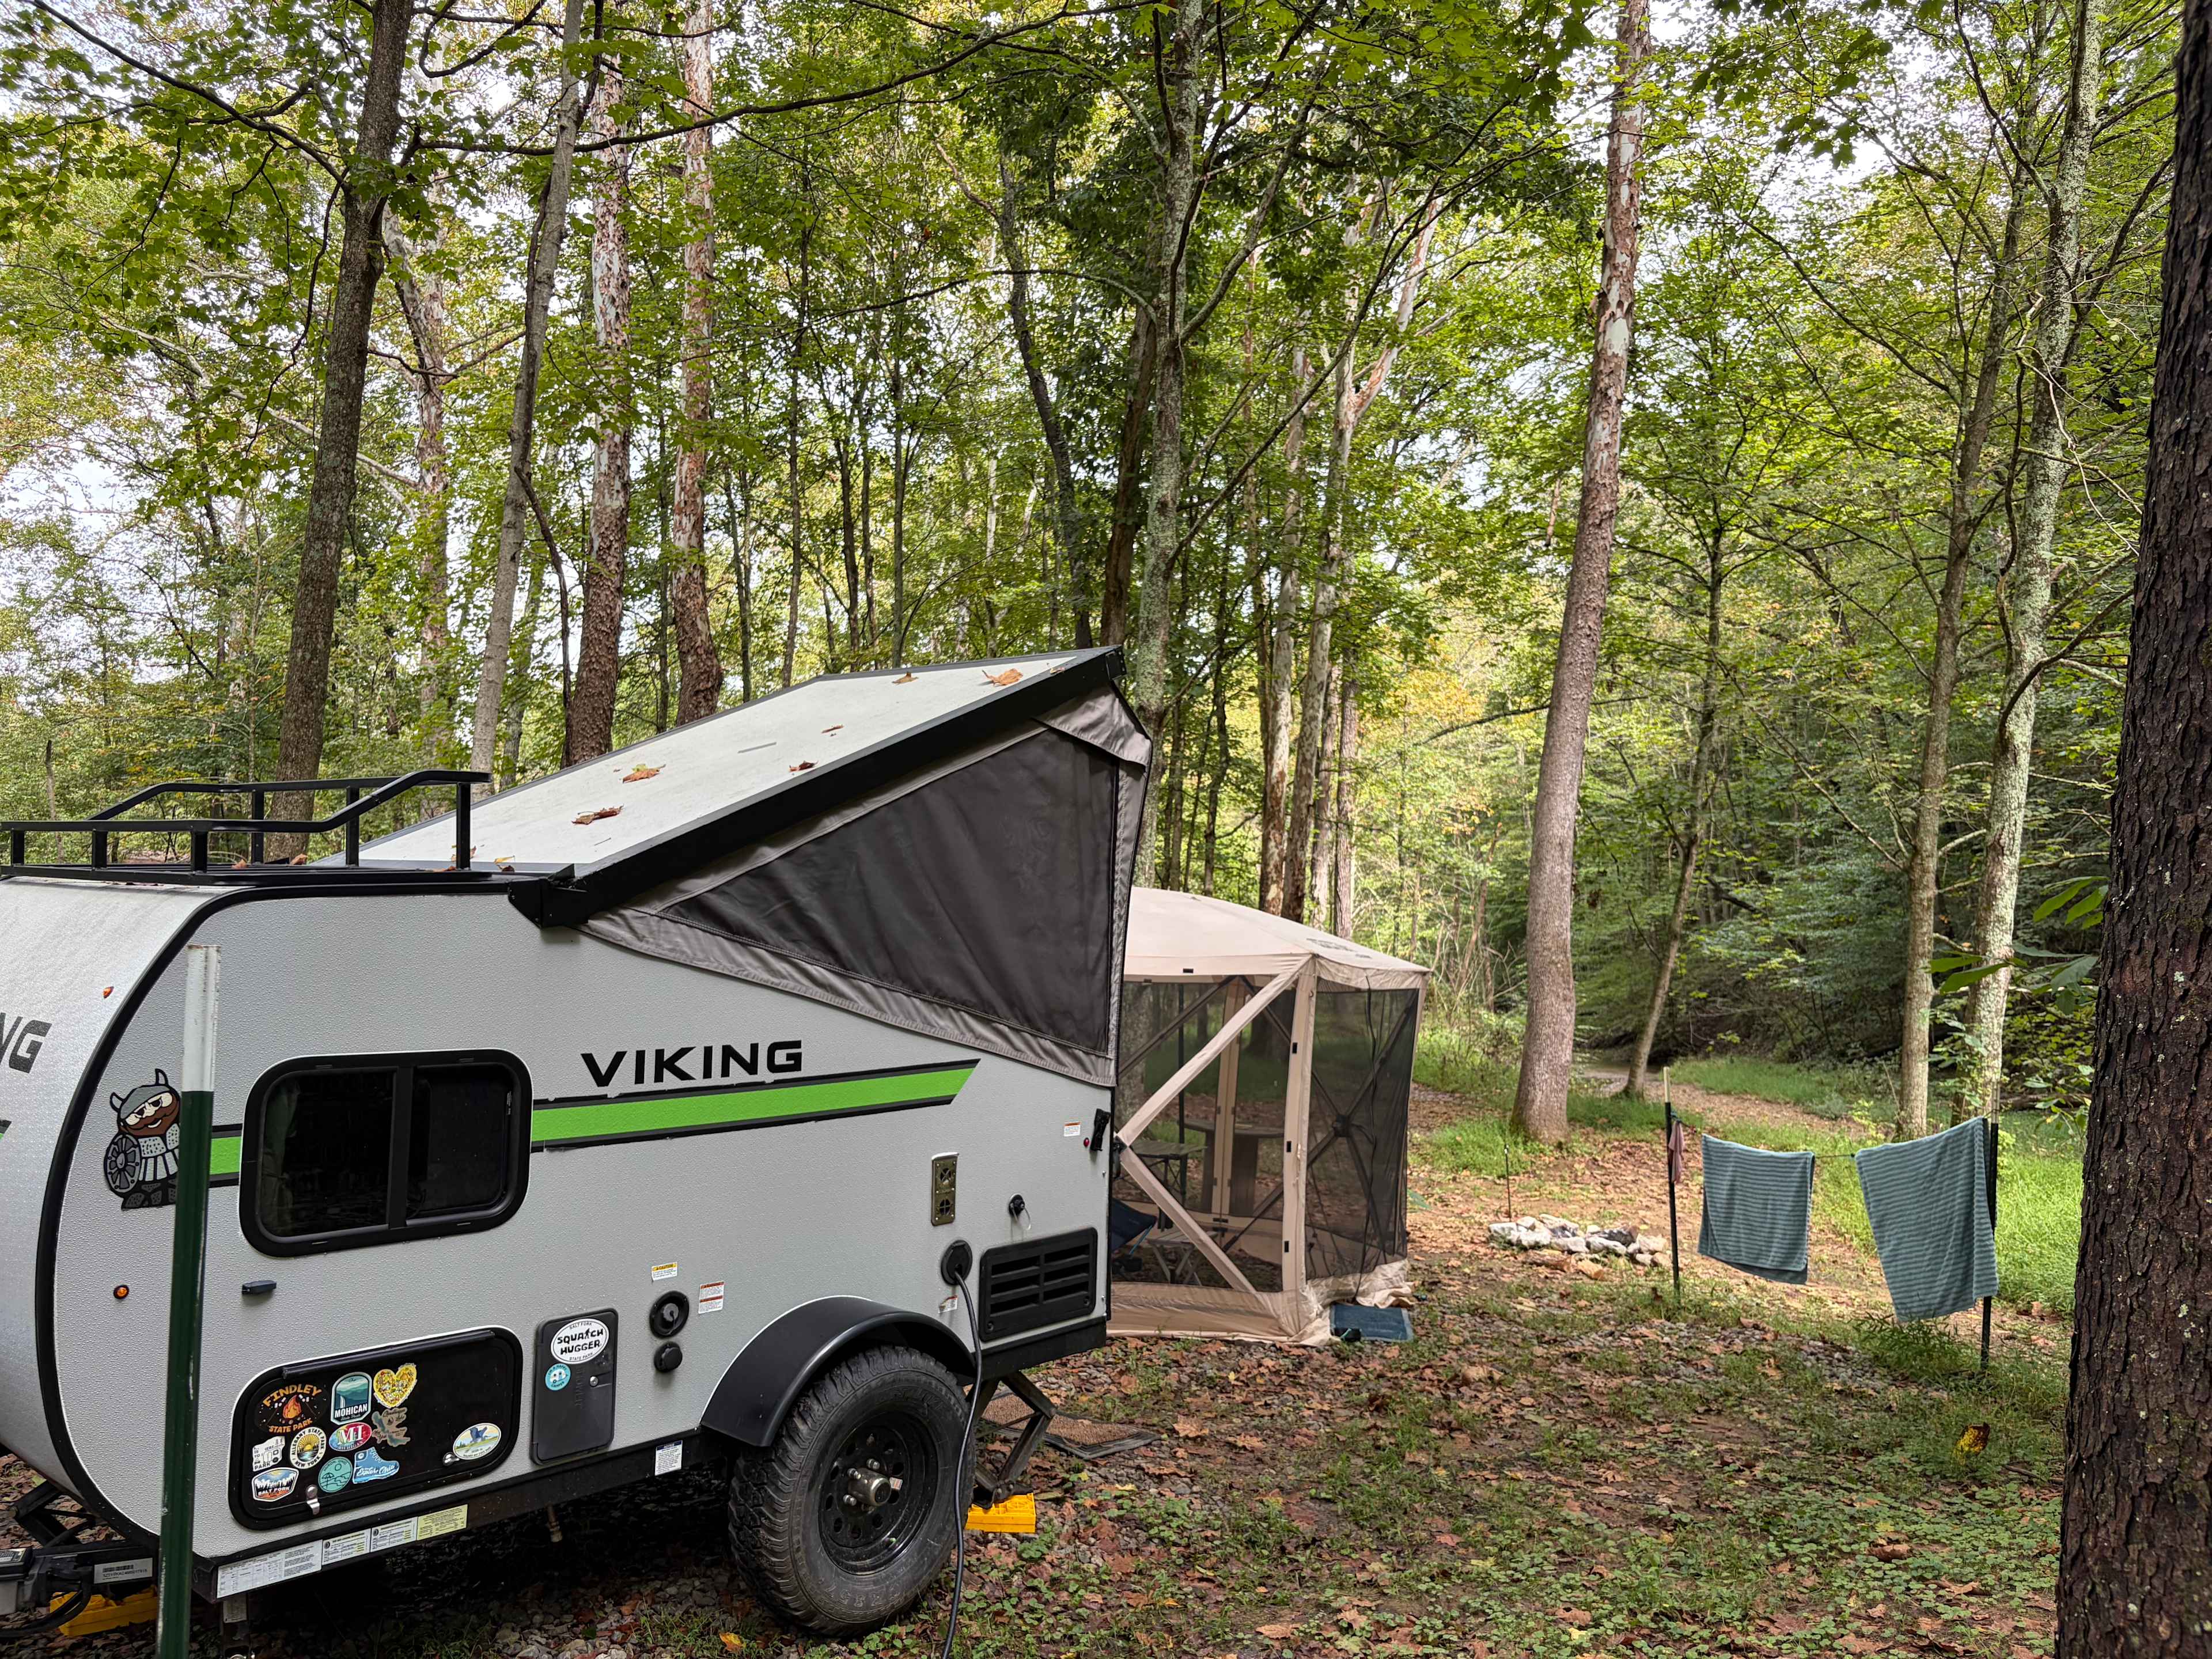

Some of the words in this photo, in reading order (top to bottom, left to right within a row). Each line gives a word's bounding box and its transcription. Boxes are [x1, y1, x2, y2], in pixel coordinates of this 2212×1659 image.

[581, 1040, 802, 1088] VIKING
[560, 1340, 600, 1355] HUGGER
[263, 1384, 322, 1407] FINDLEY
[335, 1403, 368, 1418] MOHICAN
[293, 1418, 313, 1431] PARK
[338, 1425, 365, 1445] MI
[254, 1461, 270, 1470] PARK
[308, 1456, 320, 1466] YORK
[357, 1468, 378, 1476] Explore
[379, 1465, 395, 1474] Ohio
